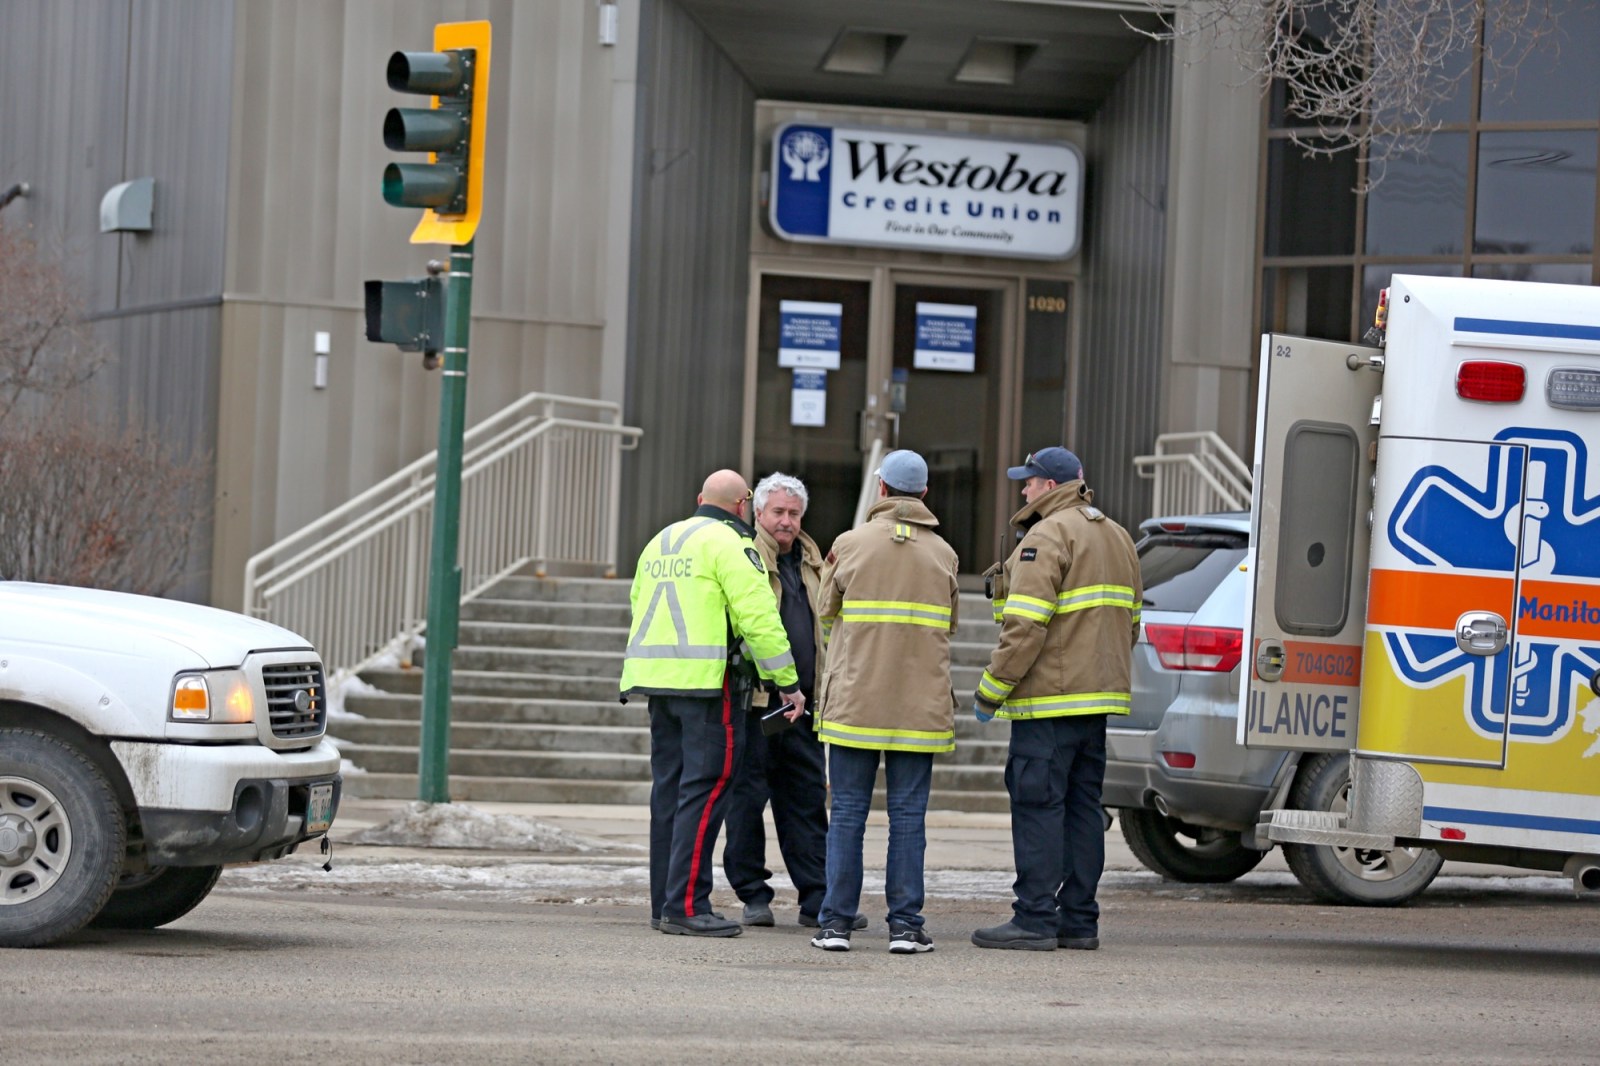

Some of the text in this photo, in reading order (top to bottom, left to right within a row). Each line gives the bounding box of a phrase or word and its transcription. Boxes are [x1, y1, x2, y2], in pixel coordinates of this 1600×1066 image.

[842, 138, 1069, 197] Westoba
[842, 191, 1061, 223] Credit Union
[885, 219, 1014, 243] First in Our Community
[1029, 296, 1066, 312] 1020
[644, 558, 693, 579] POLICE
[1295, 652, 1355, 676] 704G02
